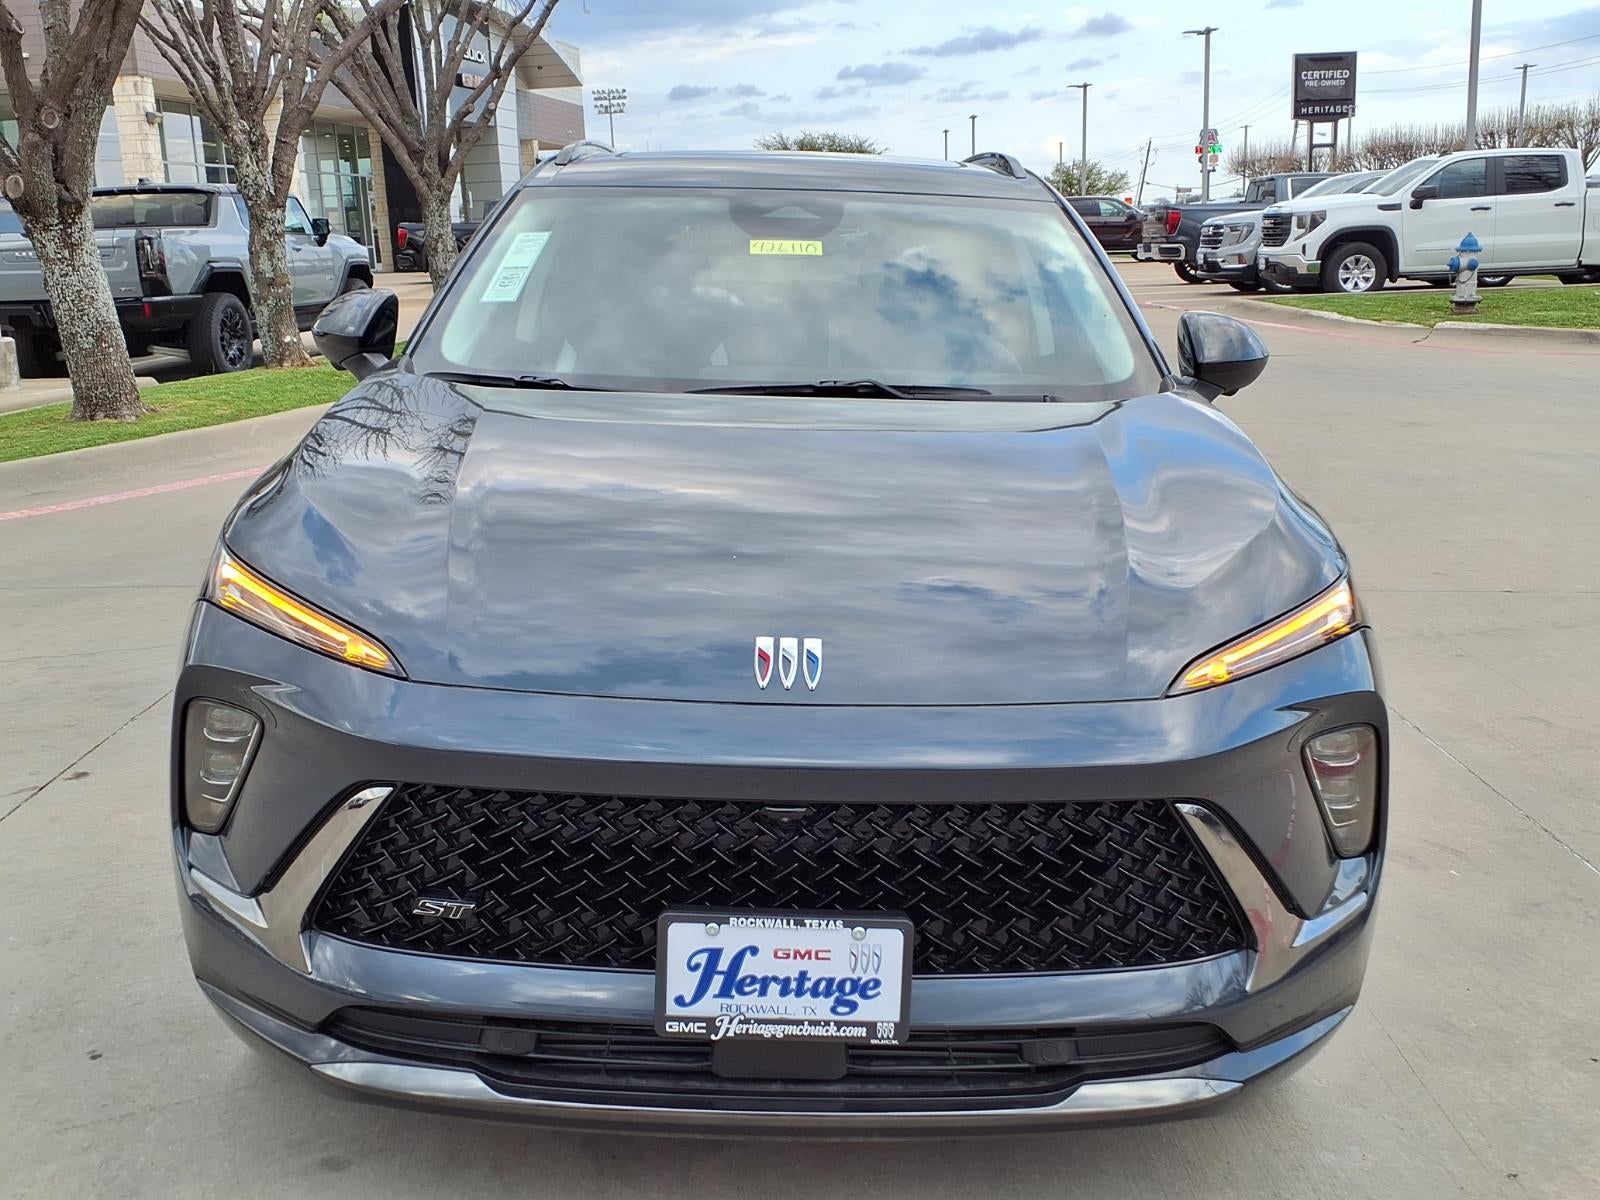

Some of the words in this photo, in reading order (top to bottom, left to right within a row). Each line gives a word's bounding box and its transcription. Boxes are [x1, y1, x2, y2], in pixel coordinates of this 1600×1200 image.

[1301, 69, 1350, 80] CERTIFIED
[1304, 79, 1346, 87] PRE-OWNED
[1301, 105, 1349, 114] HERITAGE
[412, 899, 476, 919] ST
[729, 917, 800, 930] ROCKWALL,
[804, 919, 844, 930] TEXAS
[773, 948, 831, 960] GMC
[673, 944, 882, 1016] Heritage
[803, 1006, 817, 1016] TX
[665, 1021, 707, 1033] GMC
[710, 1014, 867, 1041] Heritagegmcbuick.com
